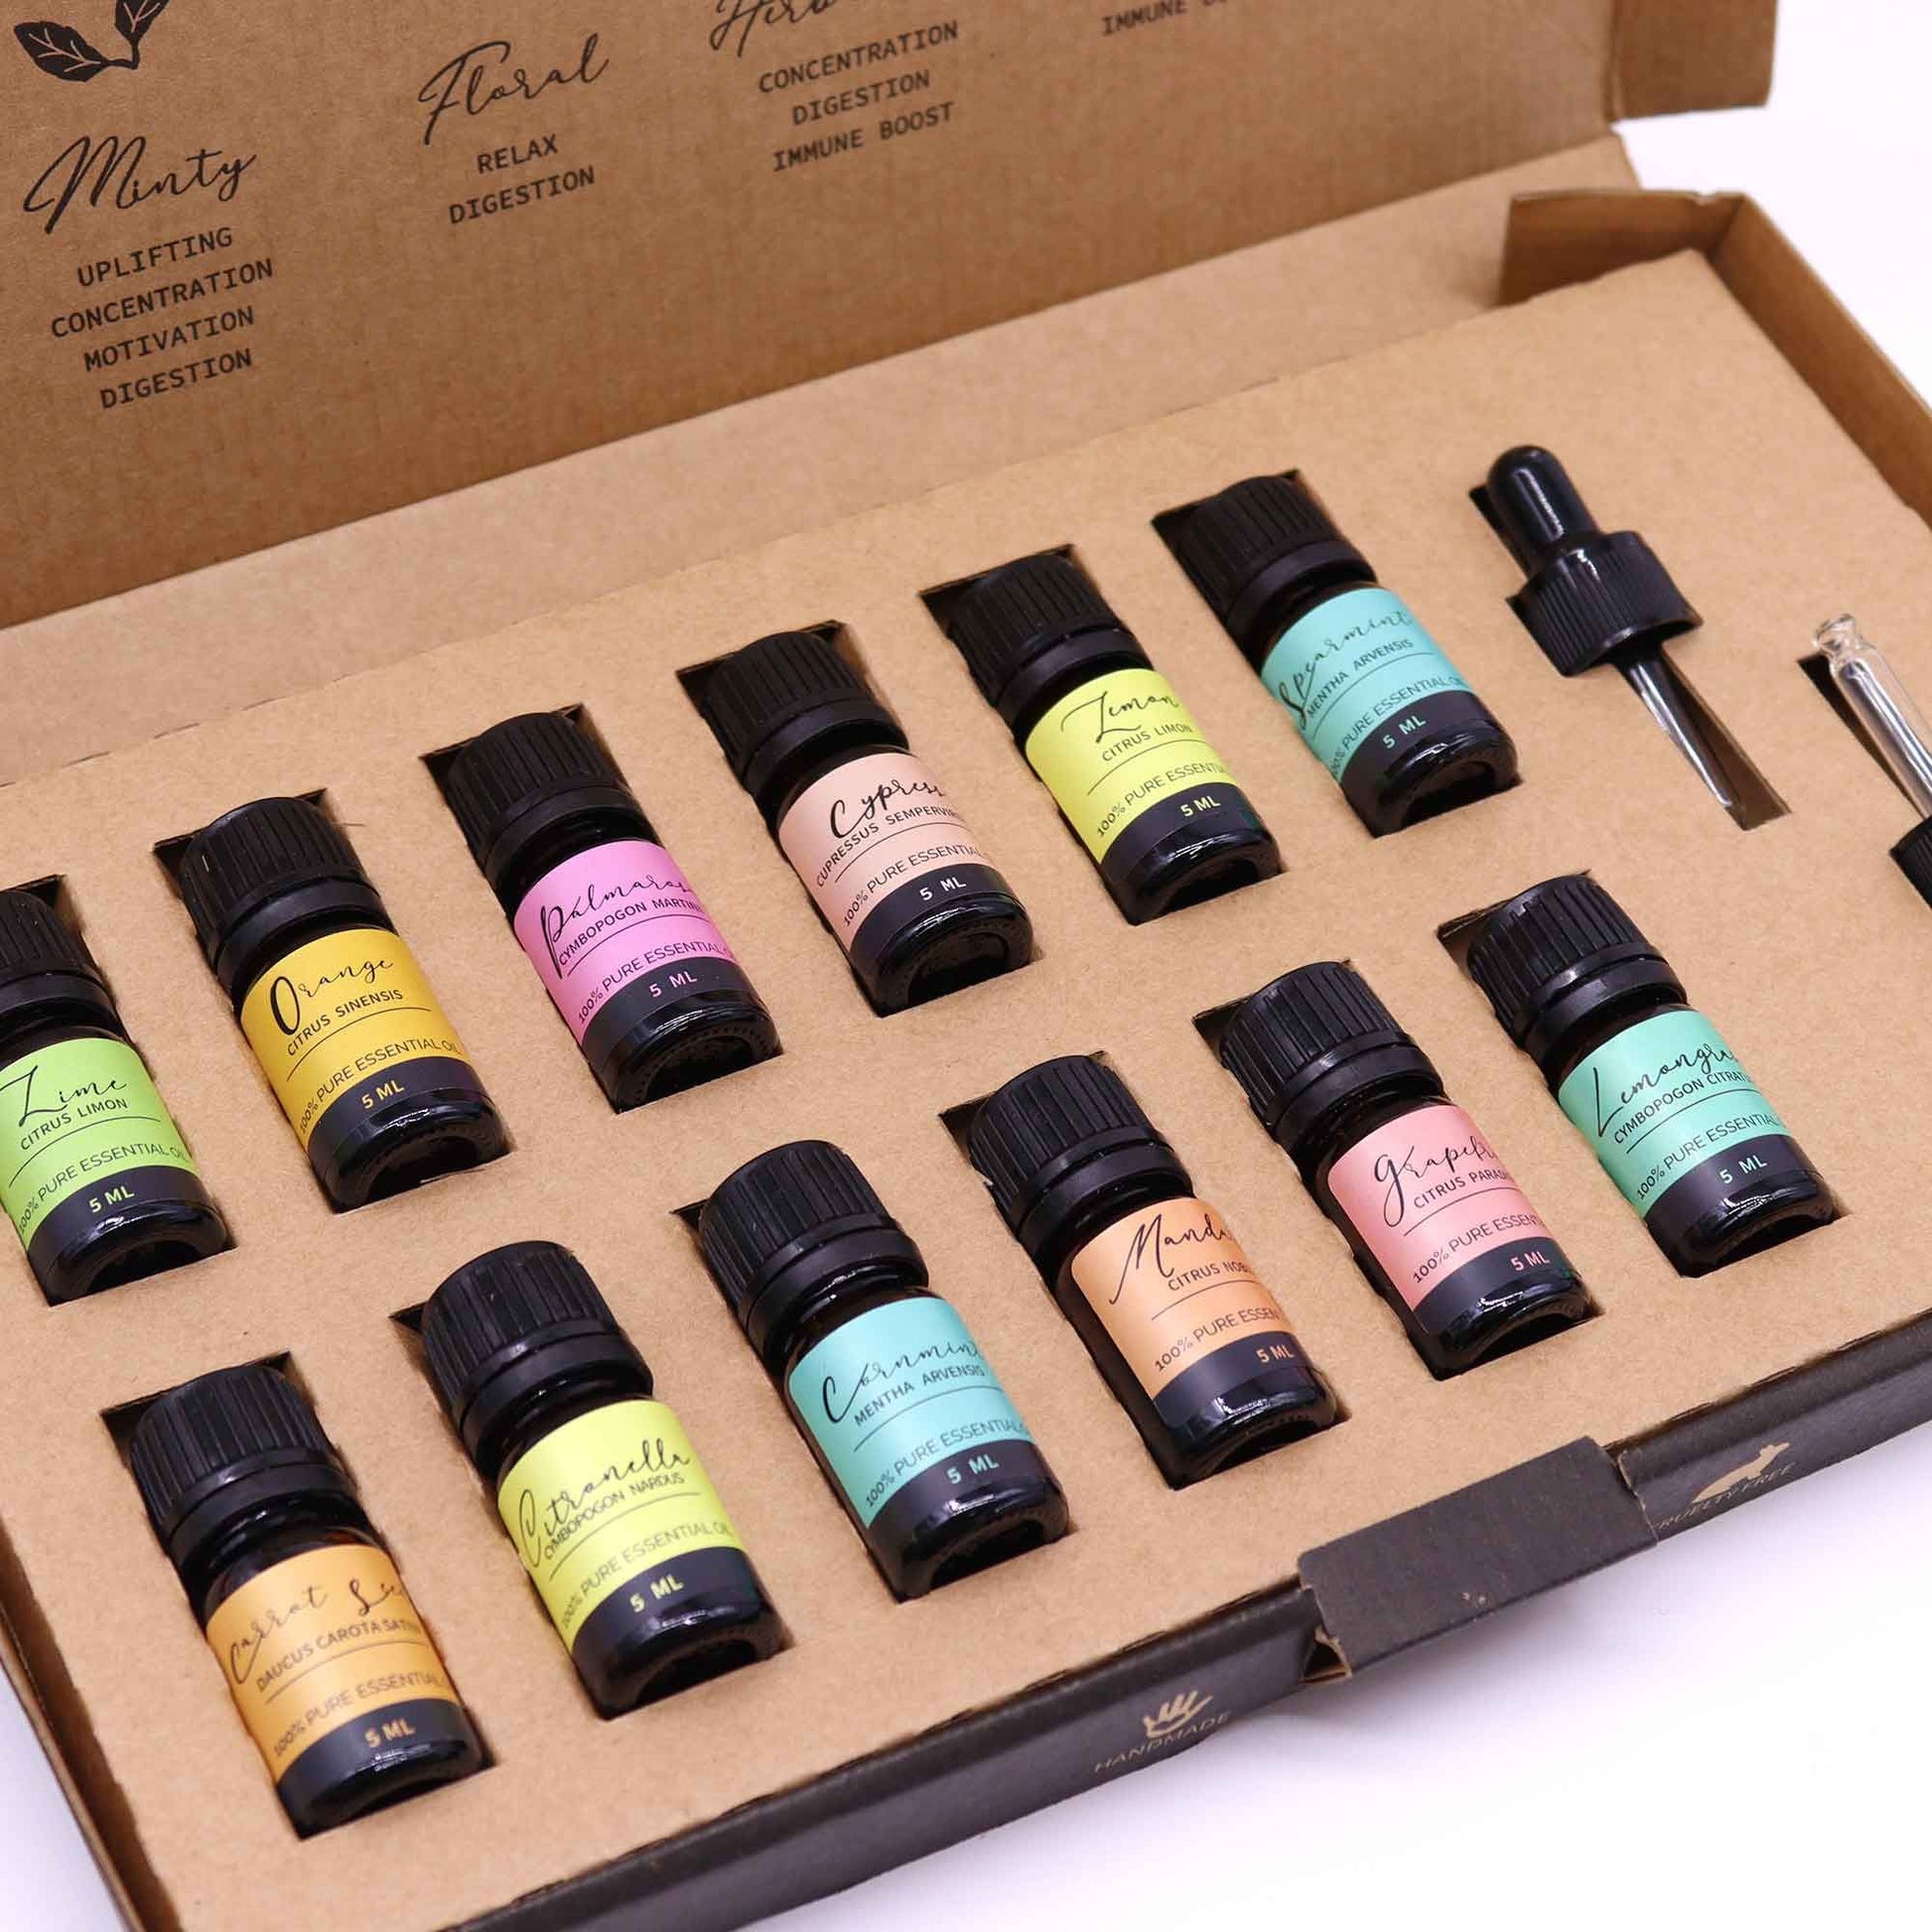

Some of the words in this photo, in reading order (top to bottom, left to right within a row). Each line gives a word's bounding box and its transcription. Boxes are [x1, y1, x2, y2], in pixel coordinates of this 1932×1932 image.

[1101, 0, 1188, 36] IMMUNE
[758, 20, 959, 93] CONCENTRATION
[418, 33, 610, 146] Floral
[791, 69, 931, 126] DIGESTION
[477, 133, 559, 174] RELAX
[772, 129, 865, 173] IMMUNE
[880, 101, 955, 142] BOOST
[23, 135, 257, 234] Minty
[449, 165, 596, 224] DIGESTION
[76, 226, 233, 288] UPLIFTING
[51, 258, 274, 340] CONCENTRATION
[83, 306, 255, 372] MOTIVATION
[99, 348, 252, 410] DIGESTION
[1307, 671, 1349, 720] MENTHA
[1352, 638, 1414, 673] ARVENSIS
[1060, 690, 1179, 745] Lemon
[1102, 732, 1152, 762] CITRUS
[1154, 723, 1193, 736] LIMON
[1342, 712, 1374, 749] PURE
[1382, 735, 1397, 750] 5
[1398, 715, 1428, 736] ML
[1097, 800, 1126, 838] 100%
[1124, 774, 1167, 807] PURE
[1179, 804, 1191, 817] 5
[1195, 795, 1222, 811] ML
[816, 824, 880, 888] CUPRESSUS
[843, 890, 869, 927] 100%
[867, 860, 908, 894] PURE
[919, 887, 933, 901] 5
[940, 876, 967, 893] ML
[558, 901, 647, 967] CYMBOPOGON
[270, 960, 394, 1036] Orange
[578, 986, 604, 1023] 100%
[603, 958, 642, 991] PURE
[648, 983, 662, 998] 5
[668, 970, 698, 989] ML
[287, 1014, 332, 1056] CITRUS
[336, 989, 404, 1019] SINENSIS
[0, 1065, 127, 1128] Lime
[299, 1098, 319, 1135] 100%
[316, 1065, 354, 1103] PURE
[354, 1037, 442, 1072] ESSENTIAL
[361, 1093, 374, 1110] 5
[377, 1079, 405, 1100] ML
[1613, 1077, 1705, 1145] CYMBOPOGON
[20, 1112, 72, 1151] CITRUS
[76, 1098, 129, 1118] LIMON
[38, 1166, 78, 1202] PURE
[80, 1143, 170, 1173] ESSENTIAL
[88, 1197, 101, 1213] 5
[104, 1184, 135, 1206] ML
[1413, 1175, 1466, 1209] CITRUS
[1635, 1167, 1666, 1200] 100%
[1663, 1135, 1707, 1171] PURE
[1720, 1169, 1733, 1184] 5
[1738, 1154, 1768, 1174] ML
[1168, 1263, 1221, 1292] CITRUS
[1413, 1245, 1449, 1284] 100%
[1449, 1222, 1494, 1253] PURE
[1510, 1256, 1524, 1272] 5
[1524, 1250, 1551, 1267] ML
[1154, 1335, 1194, 1373] 100%
[1193, 1312, 1239, 1343] PURE
[1255, 1348, 1269, 1364] 5
[1271, 1343, 1296, 1359] ML
[854, 1381, 915, 1427] MENTHA
[921, 1364, 986, 1387] ARVENSIS
[628, 1471, 686, 1497] NARDUS
[865, 1468, 896, 1508] 100%
[894, 1440, 938, 1476] PURE
[946, 1467, 962, 1484] 5
[968, 1452, 1000, 1475] ML
[519, 1438, 691, 1569] Citronella
[581, 1553, 624, 1597] PURE
[621, 1521, 714, 1568] ESSENTIAL
[629, 1592, 645, 1613] 5
[650, 1574, 685, 1600] ML
[256, 1642, 314, 1693] DAUCUS
[316, 1620, 380, 1650] CAROTA
[306, 1689, 355, 1726] PURE
[363, 1728, 381, 1748] 5
[383, 1718, 417, 1742] ML
[1094, 1710, 1231, 1773] HANDMADE
